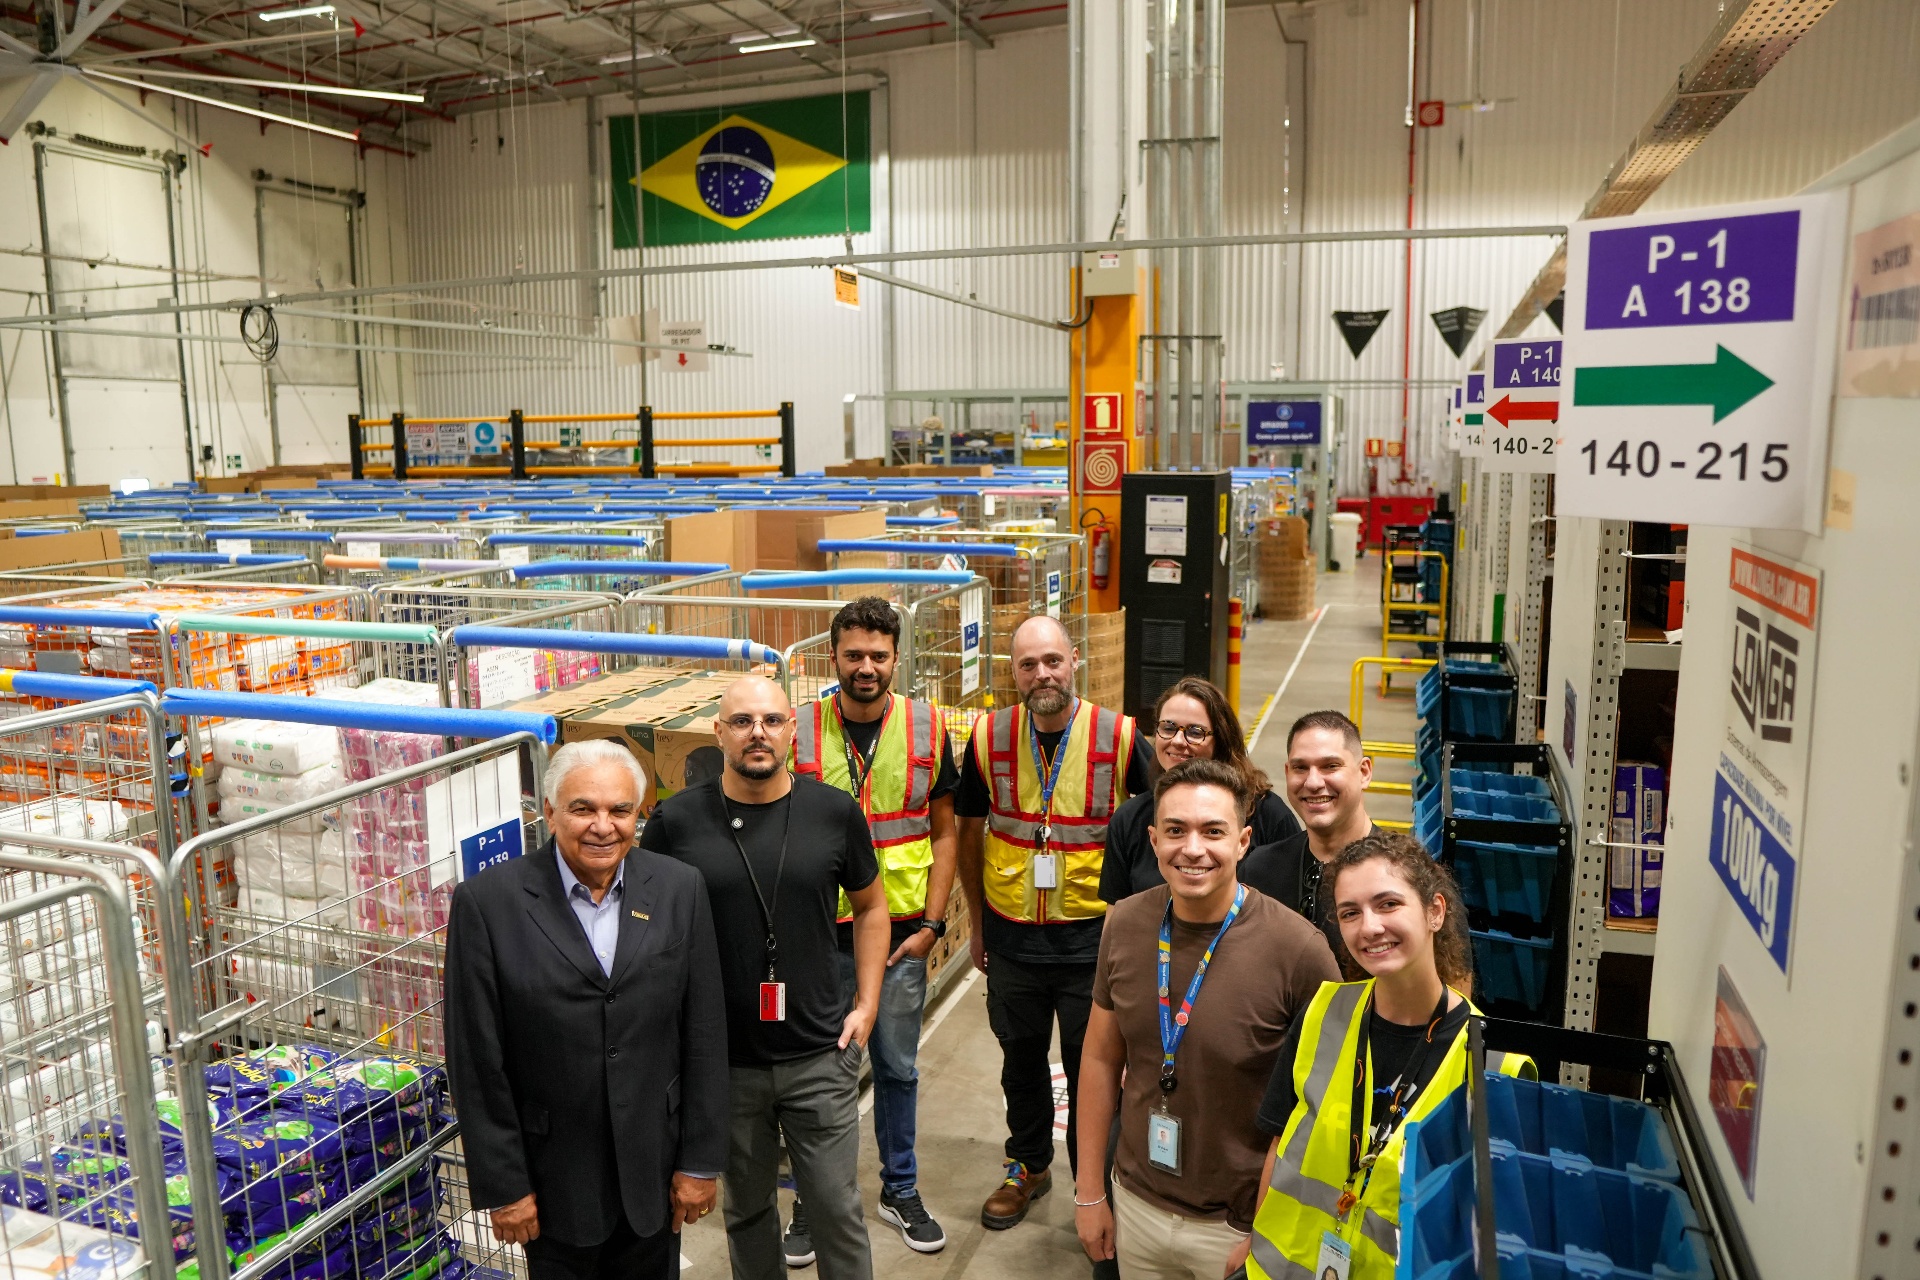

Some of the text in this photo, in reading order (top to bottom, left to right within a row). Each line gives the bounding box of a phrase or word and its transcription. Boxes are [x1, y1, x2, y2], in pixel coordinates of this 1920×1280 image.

[1647, 228, 1728, 275] P-1
[1621, 276, 1751, 318] A 138
[1509, 367, 1561, 384] A 140
[1520, 346, 1553, 365] P-1
[1579, 438, 1790, 485] 140-215
[1731, 607, 1799, 742] LONGA
[478, 829, 504, 851] P-1
[1720, 794, 1780, 949] 100kg
